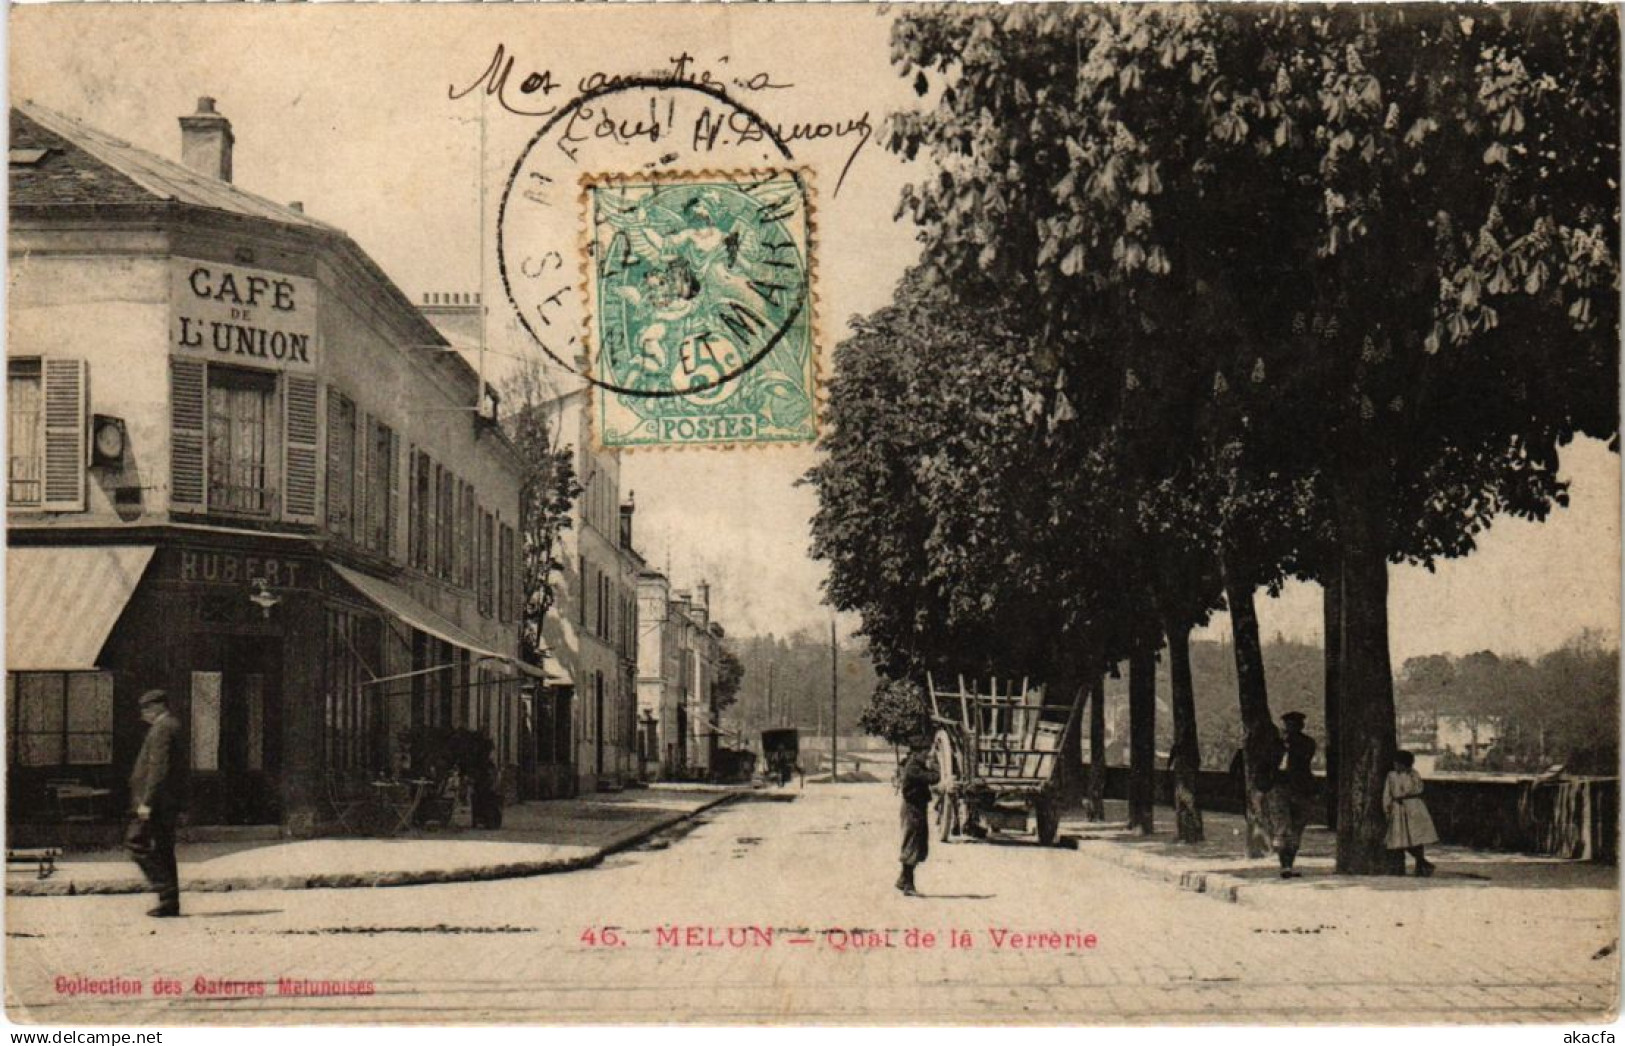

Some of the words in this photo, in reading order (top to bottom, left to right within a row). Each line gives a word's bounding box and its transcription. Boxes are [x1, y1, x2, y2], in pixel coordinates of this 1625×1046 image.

[188, 267, 296, 312] CAFÉ
[231, 307, 251, 321] DE
[178, 316, 310, 363] L'UNION
[663, 416, 754, 439] POSTES
[181, 550, 300, 587] HUBERT
